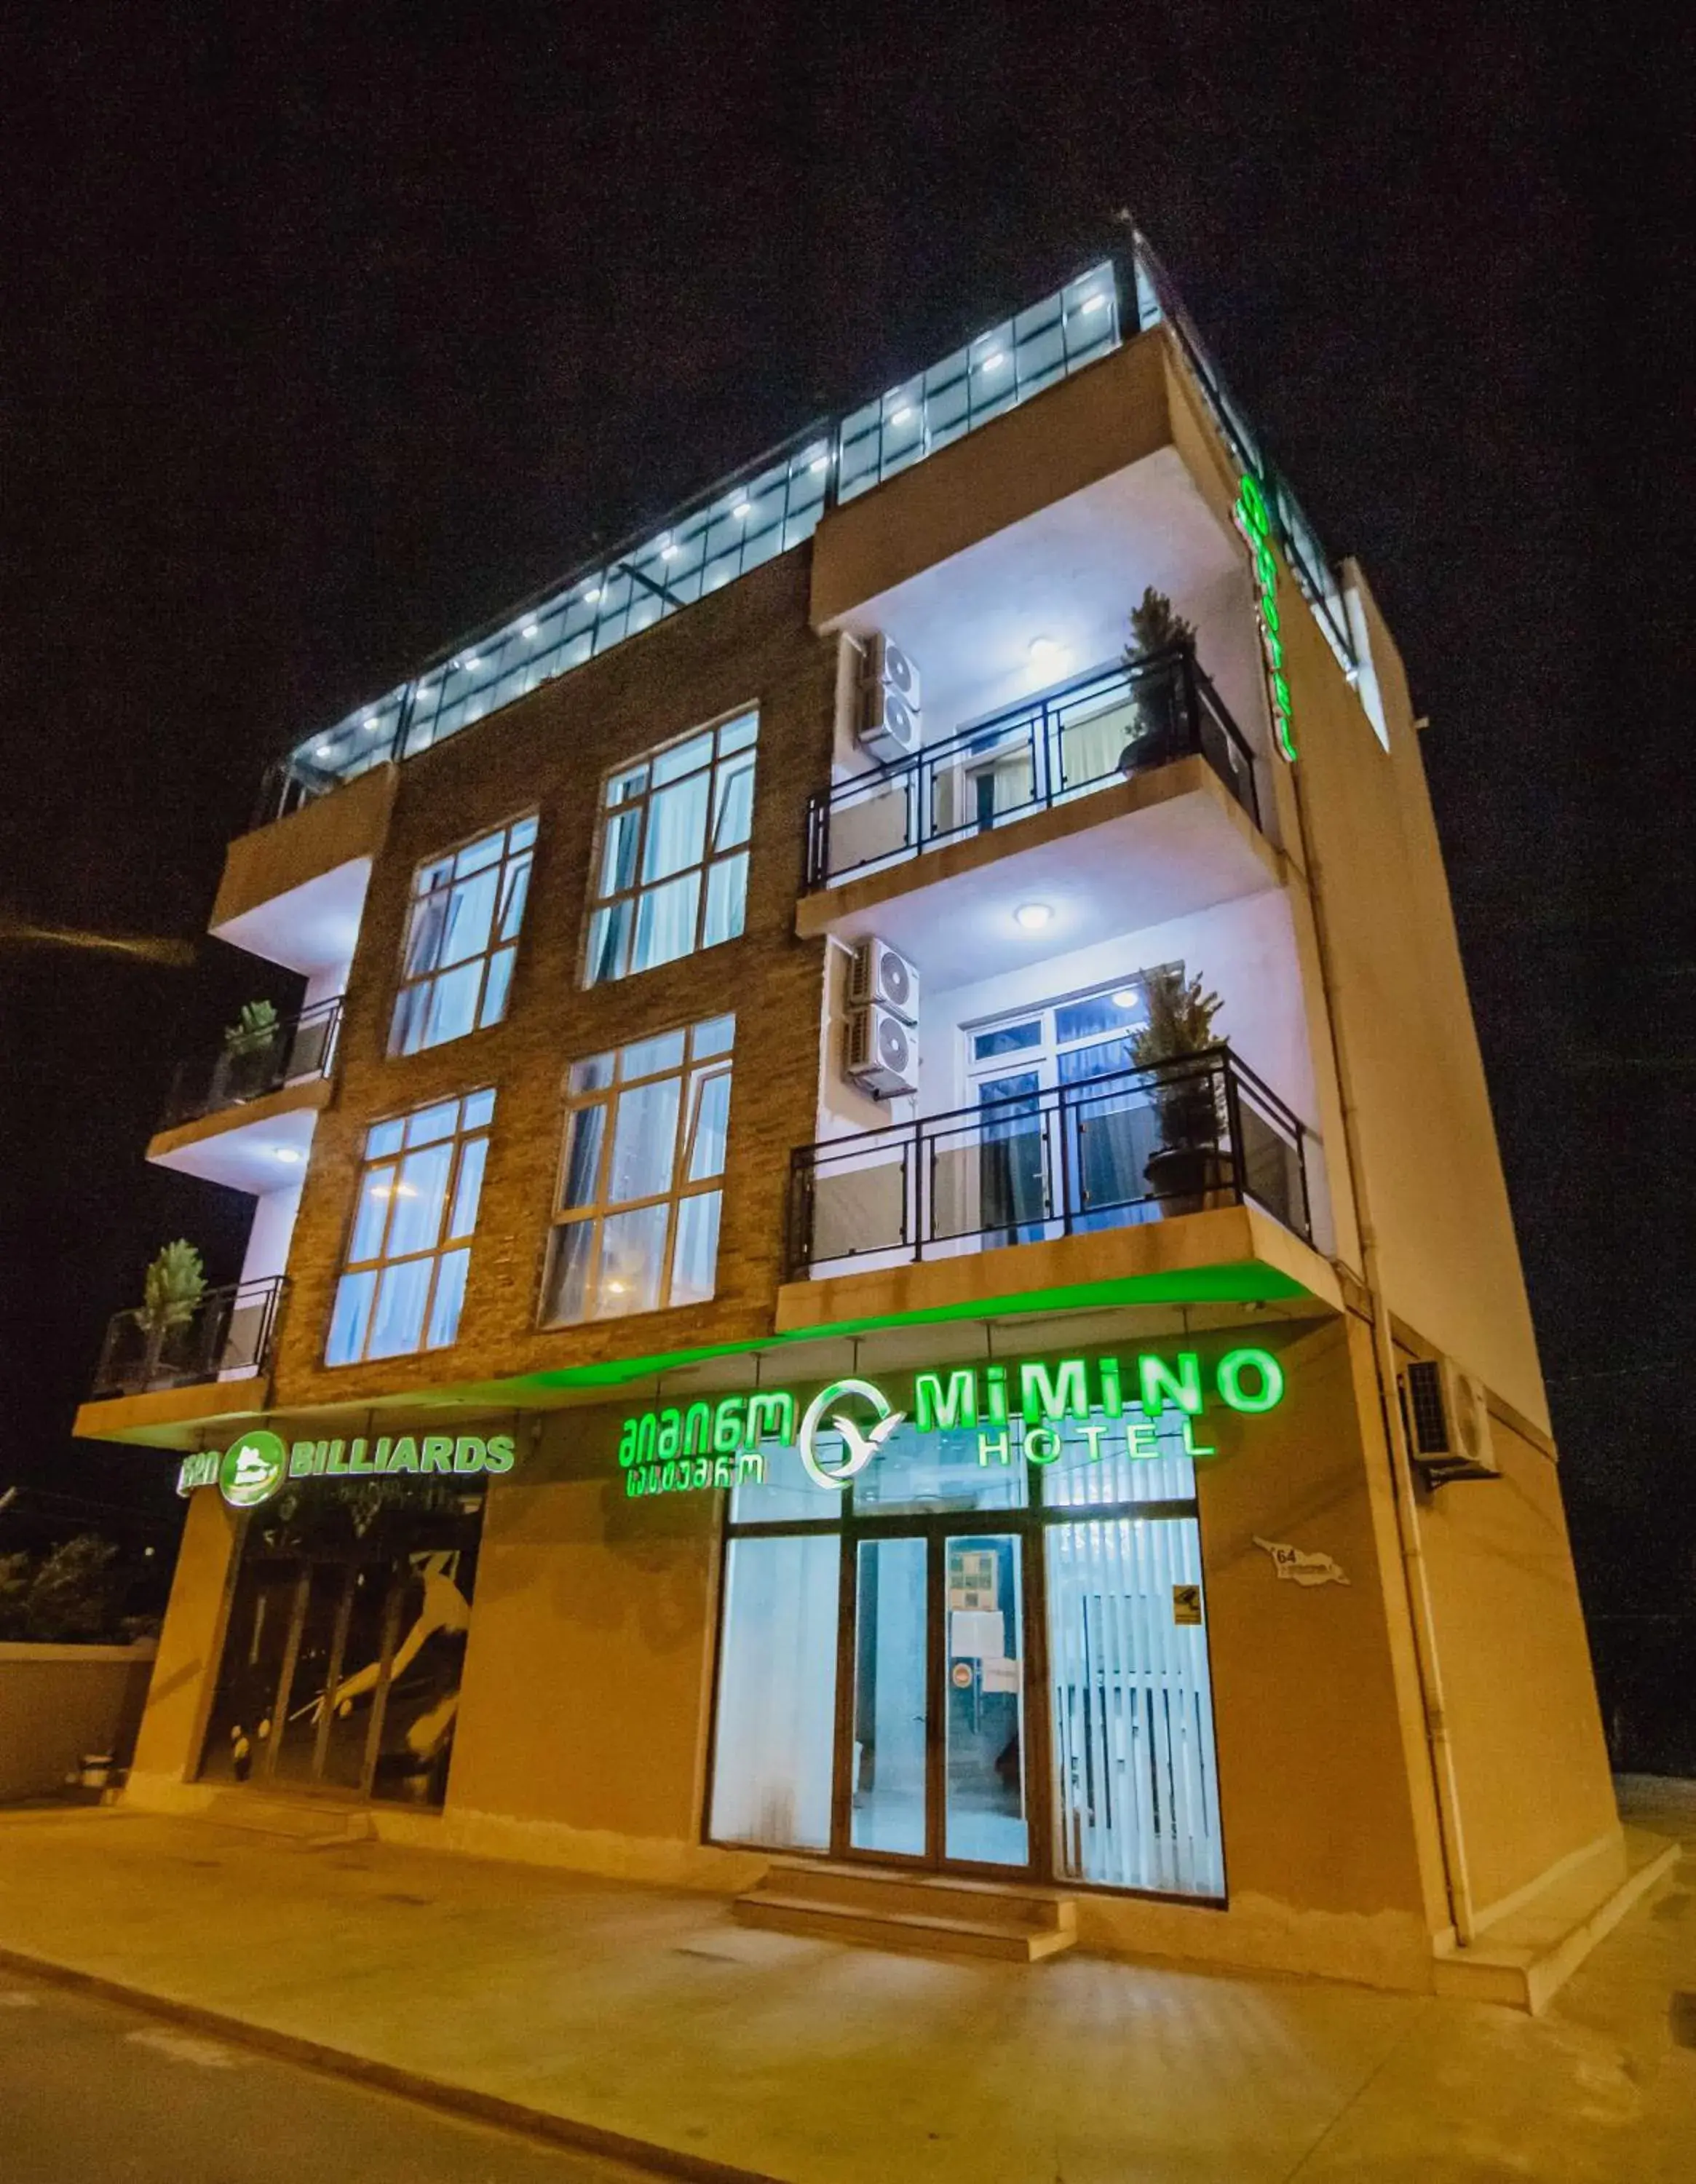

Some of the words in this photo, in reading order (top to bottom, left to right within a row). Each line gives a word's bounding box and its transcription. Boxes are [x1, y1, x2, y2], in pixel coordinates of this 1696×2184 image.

[619, 1391, 793, 1468] მიმინო
[978, 1420, 1218, 1467] HOTEL
[289, 1436, 515, 1475] BILLIARDS
[627, 1454, 765, 1497] სასტუმრო
[1277, 1549, 1296, 1564] 64
